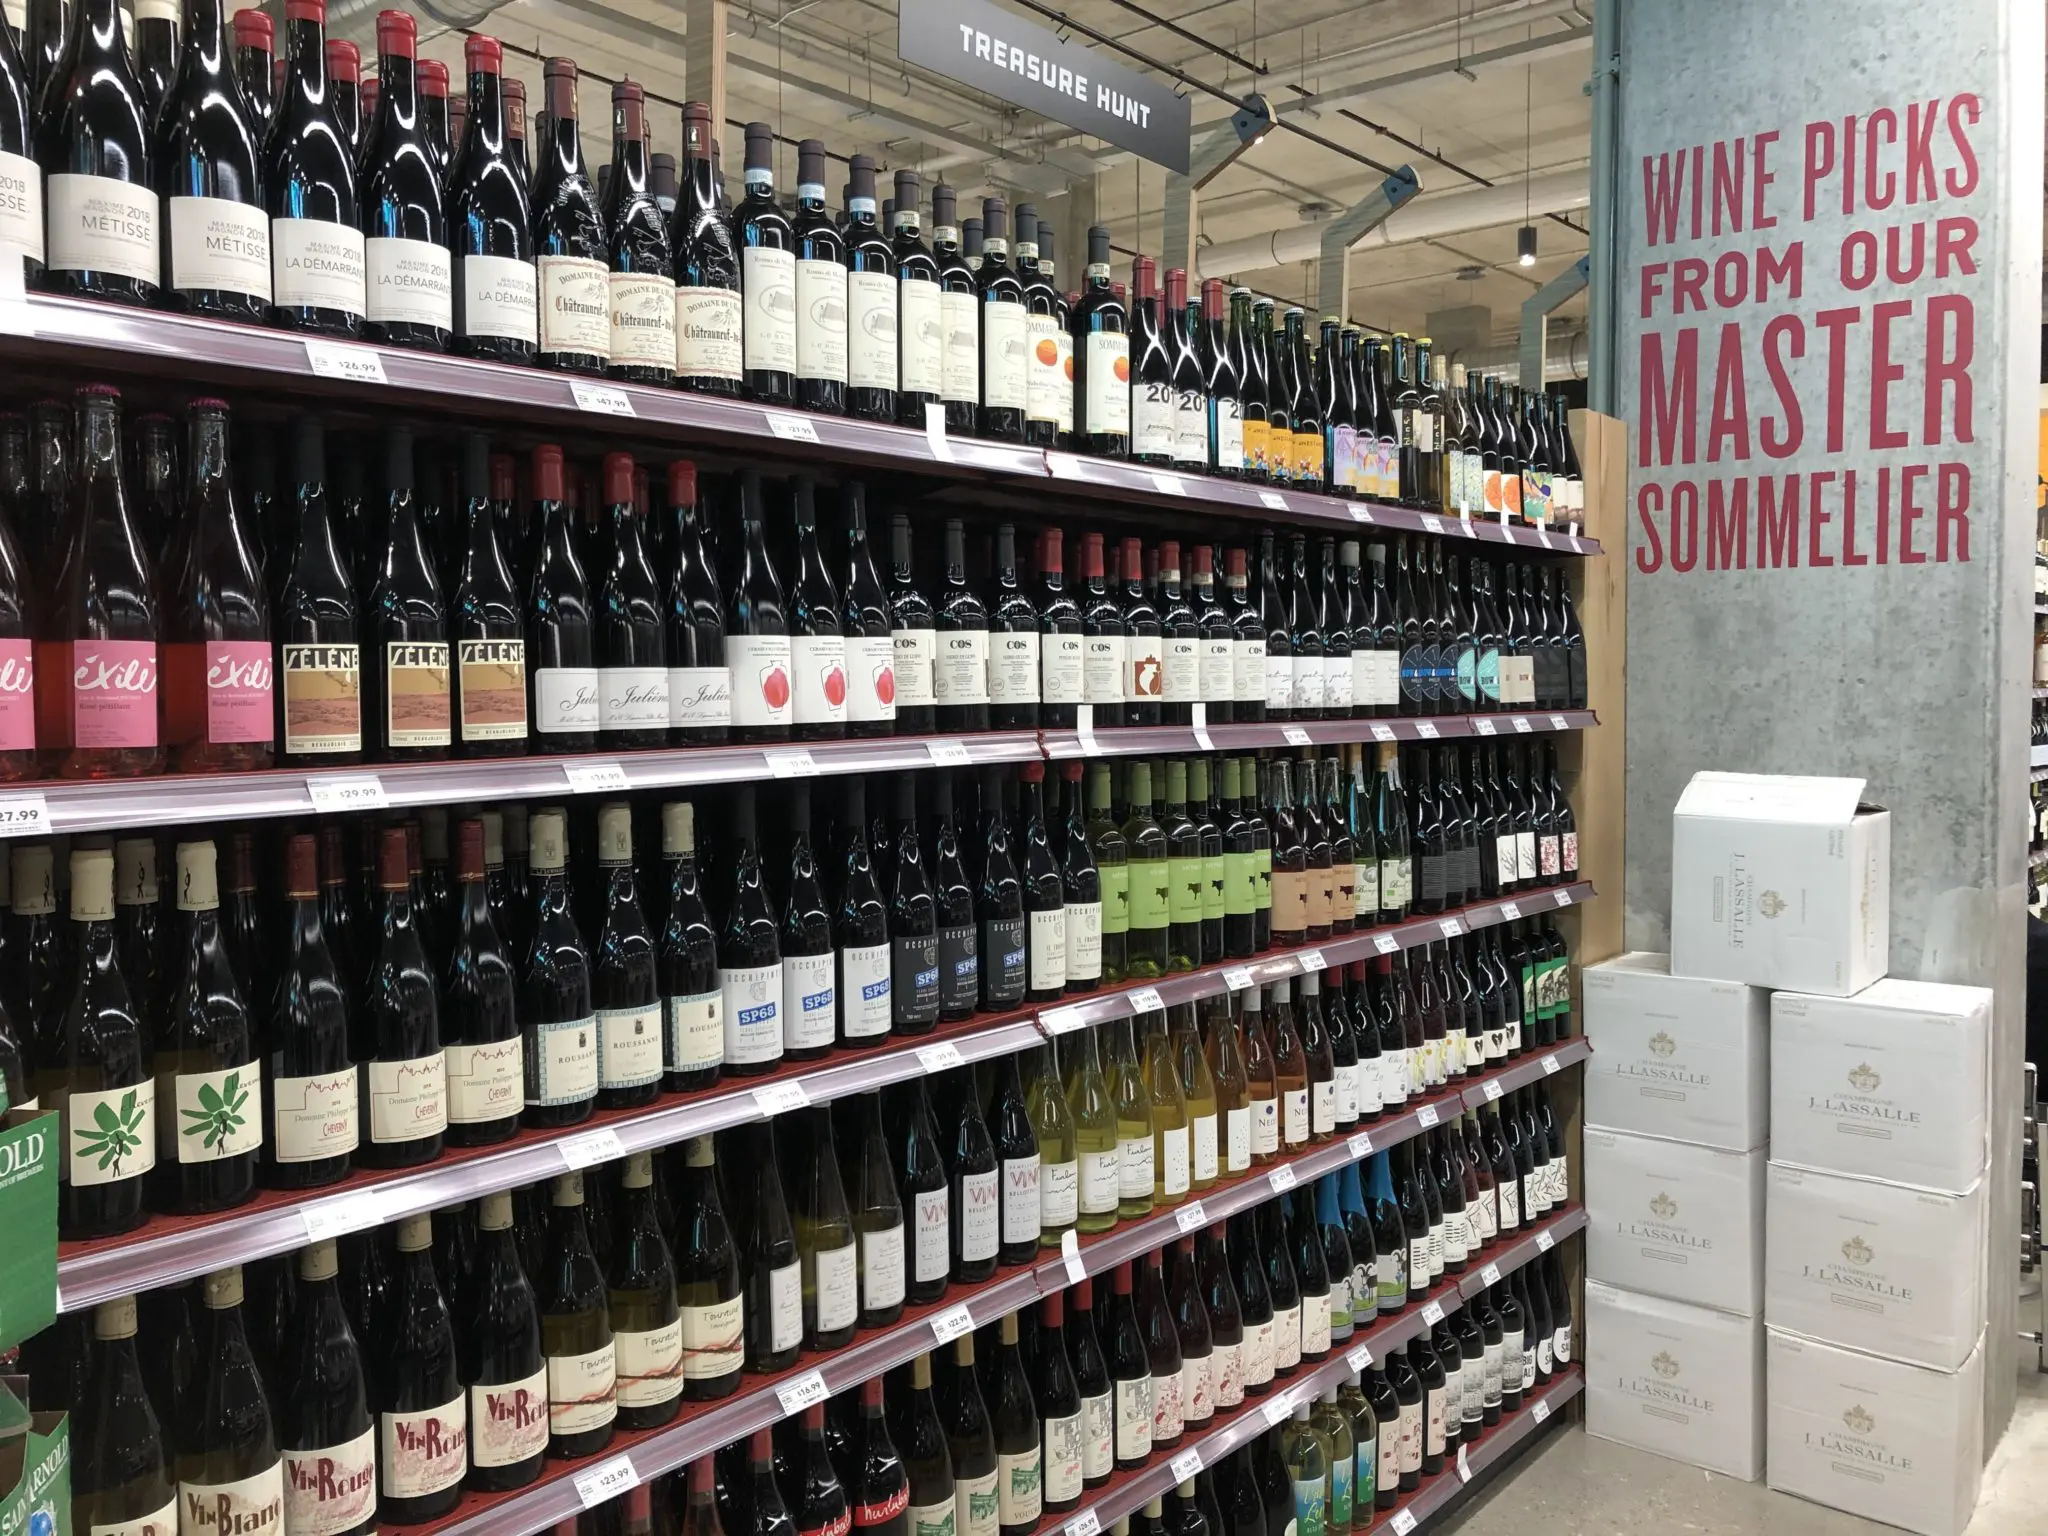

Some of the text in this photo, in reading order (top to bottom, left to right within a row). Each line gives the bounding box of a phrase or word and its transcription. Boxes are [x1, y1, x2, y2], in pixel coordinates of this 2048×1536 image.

[959, 24, 1151, 129] TREASURE HUNT
[1642, 92, 1981, 247] WINE PICKS
[126, 206, 151, 224] 2018
[81, 214, 151, 242] MÉTISSE
[246, 227, 266, 243] 2018
[206, 234, 267, 260] MÉTISSE
[342, 247, 362, 263] 2018
[285, 254, 364, 280] LA DÉMARRAN
[430, 264, 449, 280] 2018
[1640, 216, 1978, 319] FROM OUR
[377, 273, 451, 295] LA DÉMARRAN
[478, 291, 493, 302] LA
[339, 360, 377, 373] $26.99
[1638, 294, 1975, 468] MASTER
[1636, 462, 1971, 574] SOMMELIER
[893, 638, 917, 649] COS
[949, 639, 972, 649] COS
[1006, 640, 1027, 650] COS
[1062, 641, 1079, 650] COS
[1090, 643, 1111, 652] COS
[1175, 644, 1192, 653] COS
[1211, 645, 1228, 654] COS
[1248, 646, 1263, 655] COS
[339, 788, 377, 799] $29.99
[1731, 867, 1746, 949] LASSALLE
[865, 980, 890, 999] SP68
[804, 990, 832, 1010] SP68
[740, 1004, 776, 1024] SP68
[1615, 1062, 1711, 1086] J. LASSALLE
[488, 1084, 513, 1102] CHEVERNY
[415, 1101, 439, 1119] CHEVERNY
[1808, 1096, 1921, 1124] J. LASSALLE
[322, 1118, 348, 1137] CHEVERNY
[921, 1201, 948, 1225] VIN
[1616, 1222, 1712, 1249] J. LASSALLE
[1802, 1264, 1913, 1300] J. LASSALLE
[947, 1314, 968, 1329] $22.99
[796, 1382, 821, 1397] $16.99
[1617, 1377, 1714, 1412] J. LASSALLE
[515, 1387, 548, 1429] Rou
[1804, 1432, 1913, 1470] J. LASSALLE
[600, 1467, 629, 1487] $23.99
[1014, 1505, 1041, 1520] VOUVR
